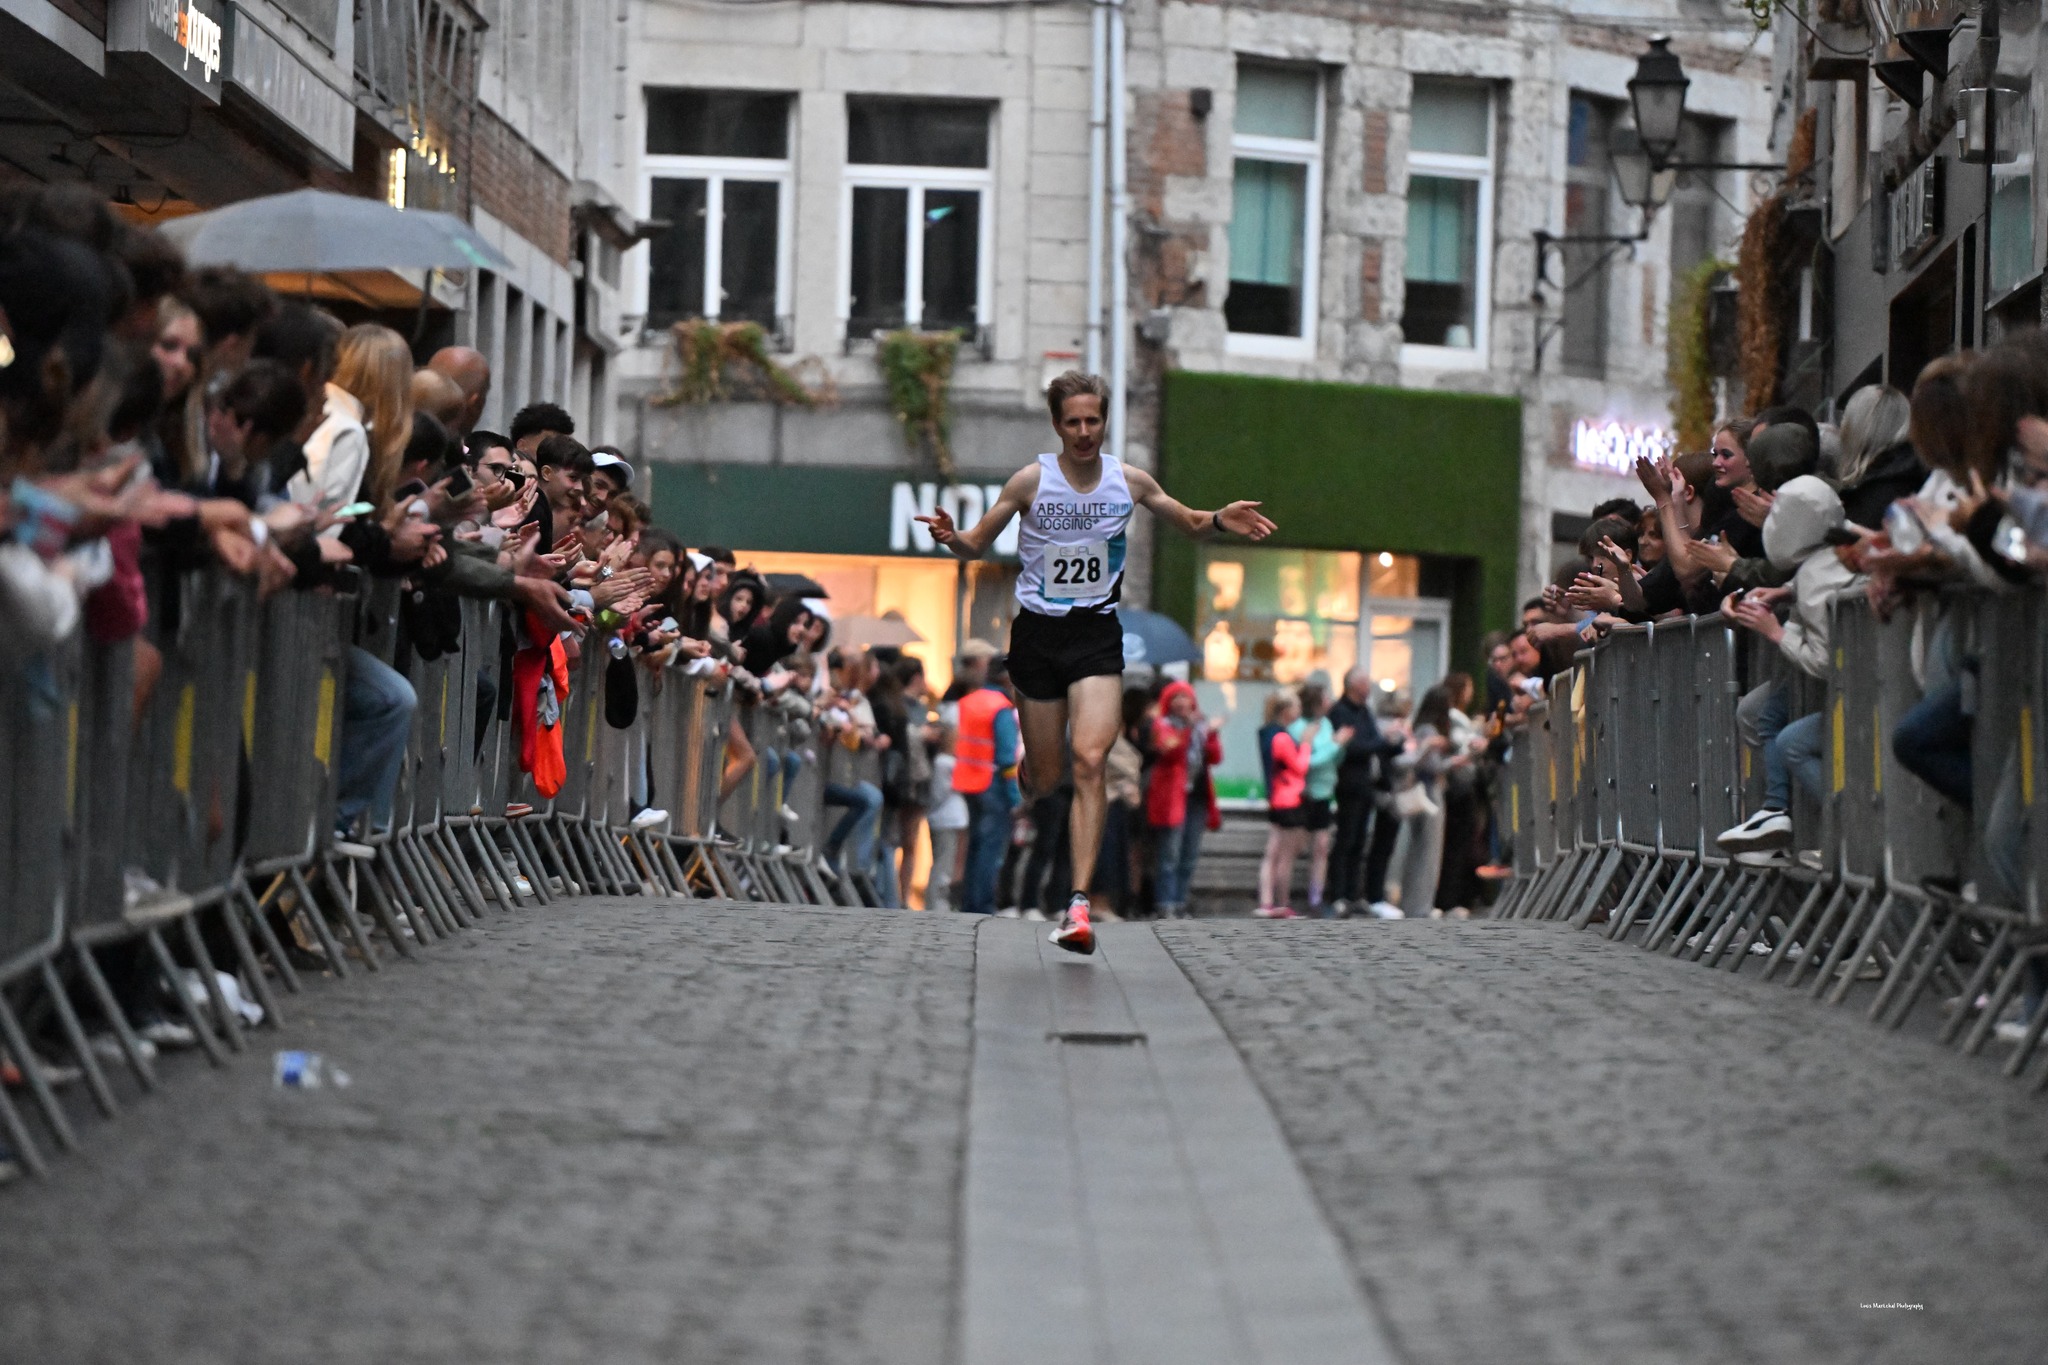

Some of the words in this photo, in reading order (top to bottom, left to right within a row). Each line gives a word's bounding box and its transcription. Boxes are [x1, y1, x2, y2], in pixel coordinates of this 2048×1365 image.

[1037, 503, 1107, 515] ABSOLUTE
[1038, 518, 1093, 530] JOGGING
[1053, 557, 1101, 584] 228
